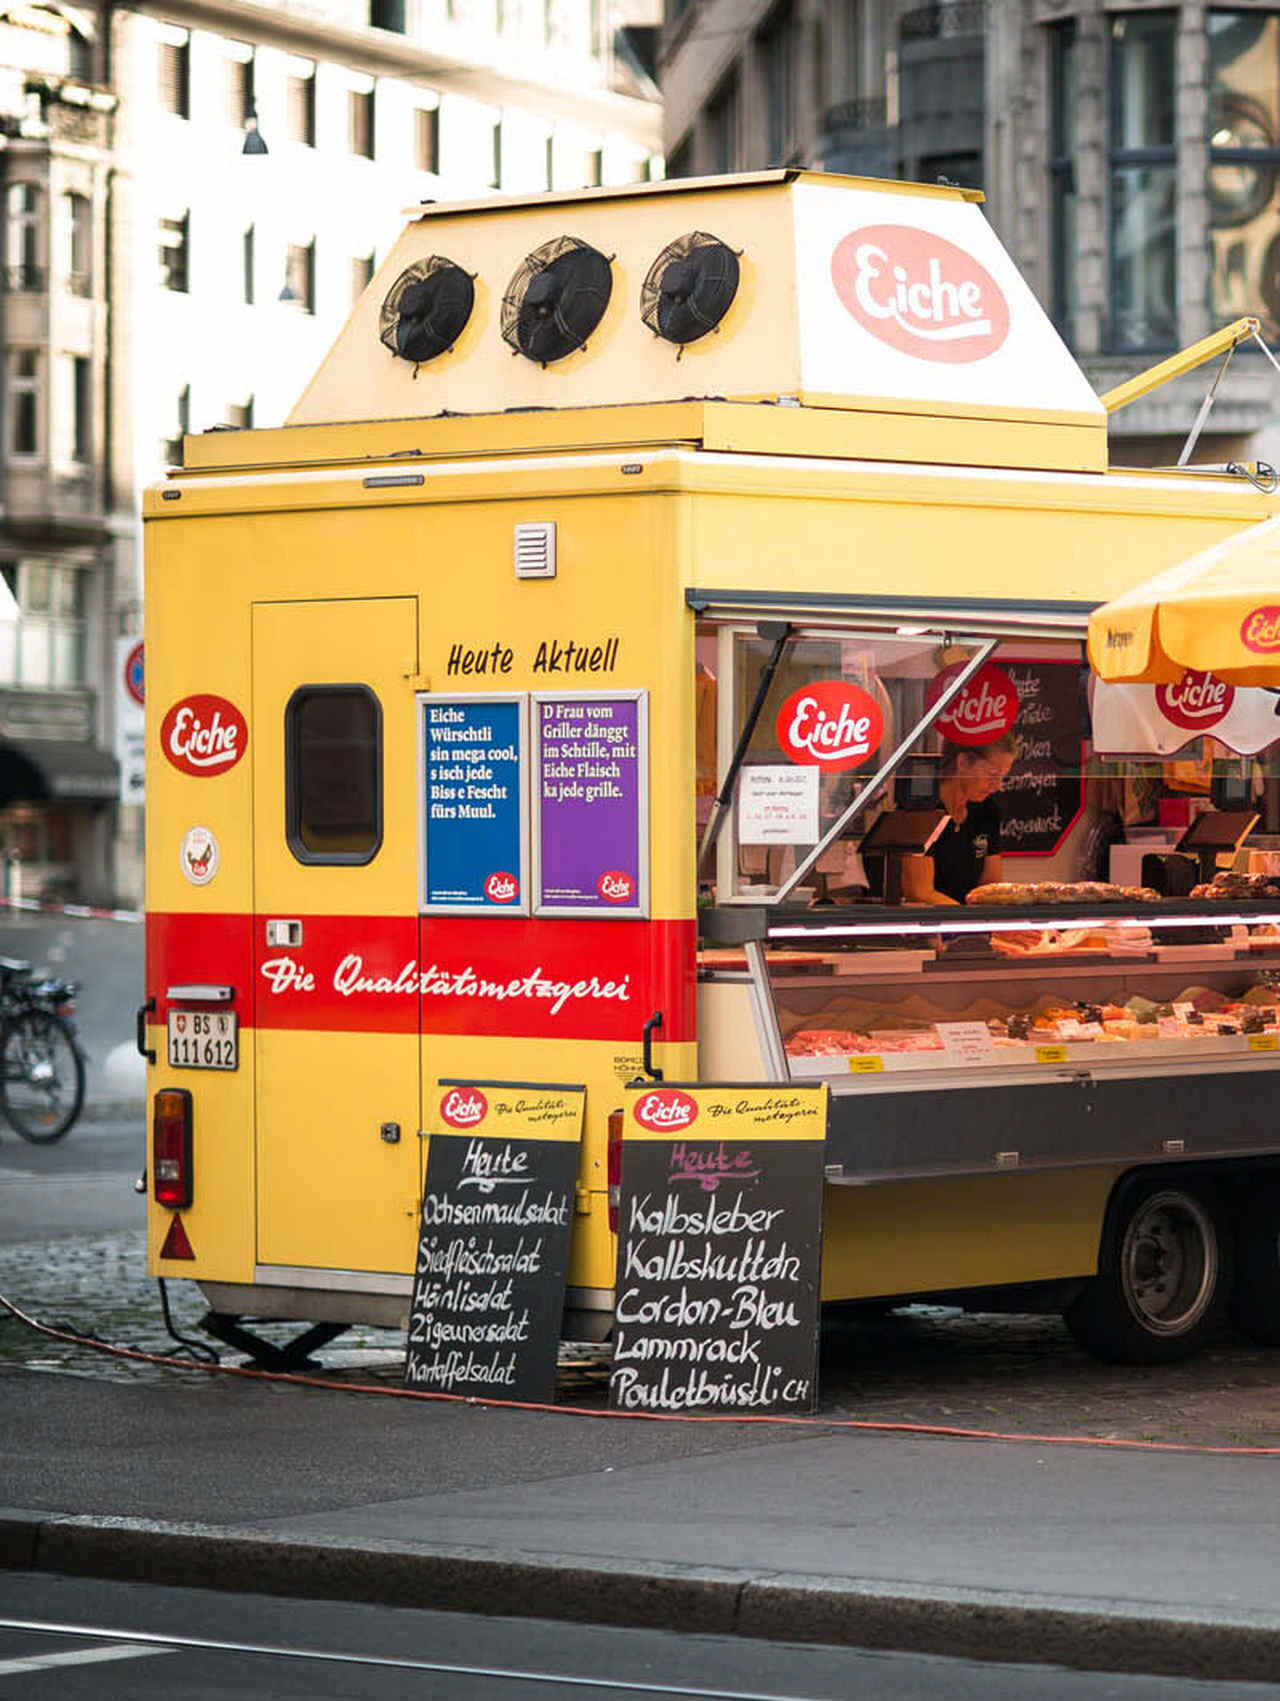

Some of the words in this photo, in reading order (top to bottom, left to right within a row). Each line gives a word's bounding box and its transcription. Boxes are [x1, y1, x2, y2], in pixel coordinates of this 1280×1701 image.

[855, 244, 991, 340] Eiche
[447, 643, 513, 675] Heute
[533, 639, 619, 674] Aktuell
[430, 708, 465, 723] Eiche
[543, 705, 554, 718] D
[556, 705, 584, 718] Frau
[586, 706, 613, 718] vom
[170, 706, 237, 767] Eiche
[430, 727, 492, 742] Würschtli
[543, 725, 582, 738] Griller
[584, 724, 628, 743] dänggt
[789, 697, 870, 760] Eiche
[430, 746, 450, 761] sin
[451, 748, 486, 764] mega
[488, 746, 518, 762] cool,
[543, 744, 559, 758] im
[561, 743, 610, 759] Schtille,
[612, 743, 636, 758] mit
[430, 768, 437, 781] s
[439, 765, 463, 781] isch
[465, 765, 492, 782] jede
[543, 763, 575, 777] Eiche
[577, 762, 620, 778] Flaisch
[430, 785, 456, 799] Biss
[457, 788, 465, 799] e
[467, 785, 507, 799] Fescht
[543, 782, 557, 798] ka
[558, 782, 584, 802] jede
[585, 781, 623, 803] grille.
[430, 804, 456, 819] fürs
[458, 804, 496, 819] Muul.
[488, 876, 516, 899] Eiche
[602, 875, 630, 897] Eiche
[262, 956, 315, 994] Die
[333, 954, 631, 1014] Qualitätsmetzgerei
[193, 1015, 210, 1034] BS
[445, 1092, 482, 1123] Eiche
[495, 1103, 513, 1115] Die
[640, 1096, 691, 1126] Eiche
[708, 1105, 732, 1117] Die
[754, 1106, 818, 1123] metzgerei
[462, 1138, 529, 1176] Heute
[670, 1141, 752, 1171] Heute
[424, 1189, 568, 1226] Ochsenmaulsalat
[629, 1191, 785, 1236] Kalbsleber
[625, 1238, 800, 1283] Kalbskutteln
[616, 1285, 801, 1329] Cordon-Bleu
[614, 1330, 761, 1363] Lammrack
[610, 1363, 782, 1409] Pouletbrüstli
[782, 1379, 809, 1401] CH
